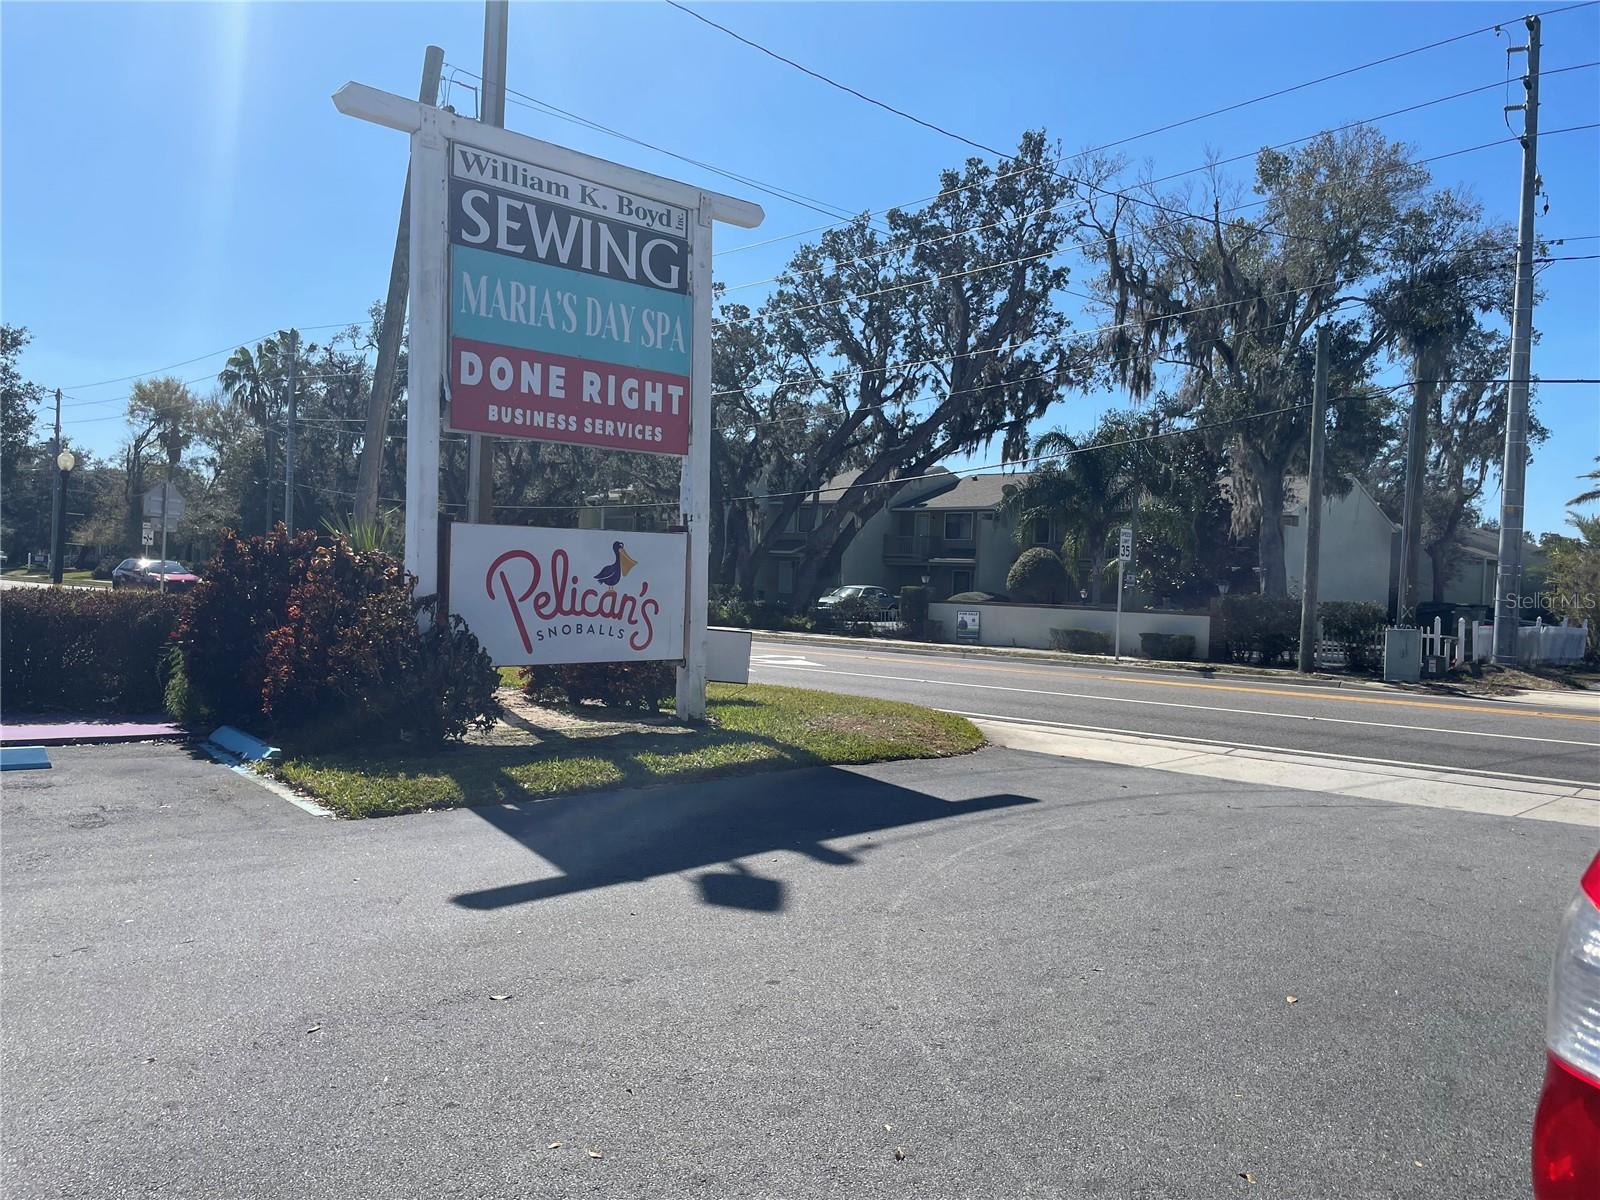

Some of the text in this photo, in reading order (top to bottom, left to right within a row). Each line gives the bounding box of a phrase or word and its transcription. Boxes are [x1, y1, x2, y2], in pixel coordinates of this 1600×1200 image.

[458, 149, 684, 231] William K. Boyd Inc.
[460, 188, 681, 290] SEWING
[460, 271, 686, 354] MARIA'S DAY SPA
[460, 350, 684, 416] DONE RIGHT
[488, 404, 663, 442] BUSINESS SERVICES
[1121, 545, 1130, 557] 35
[485, 548, 660, 655] Pelican's
[536, 623, 625, 641] SNOBALLS
